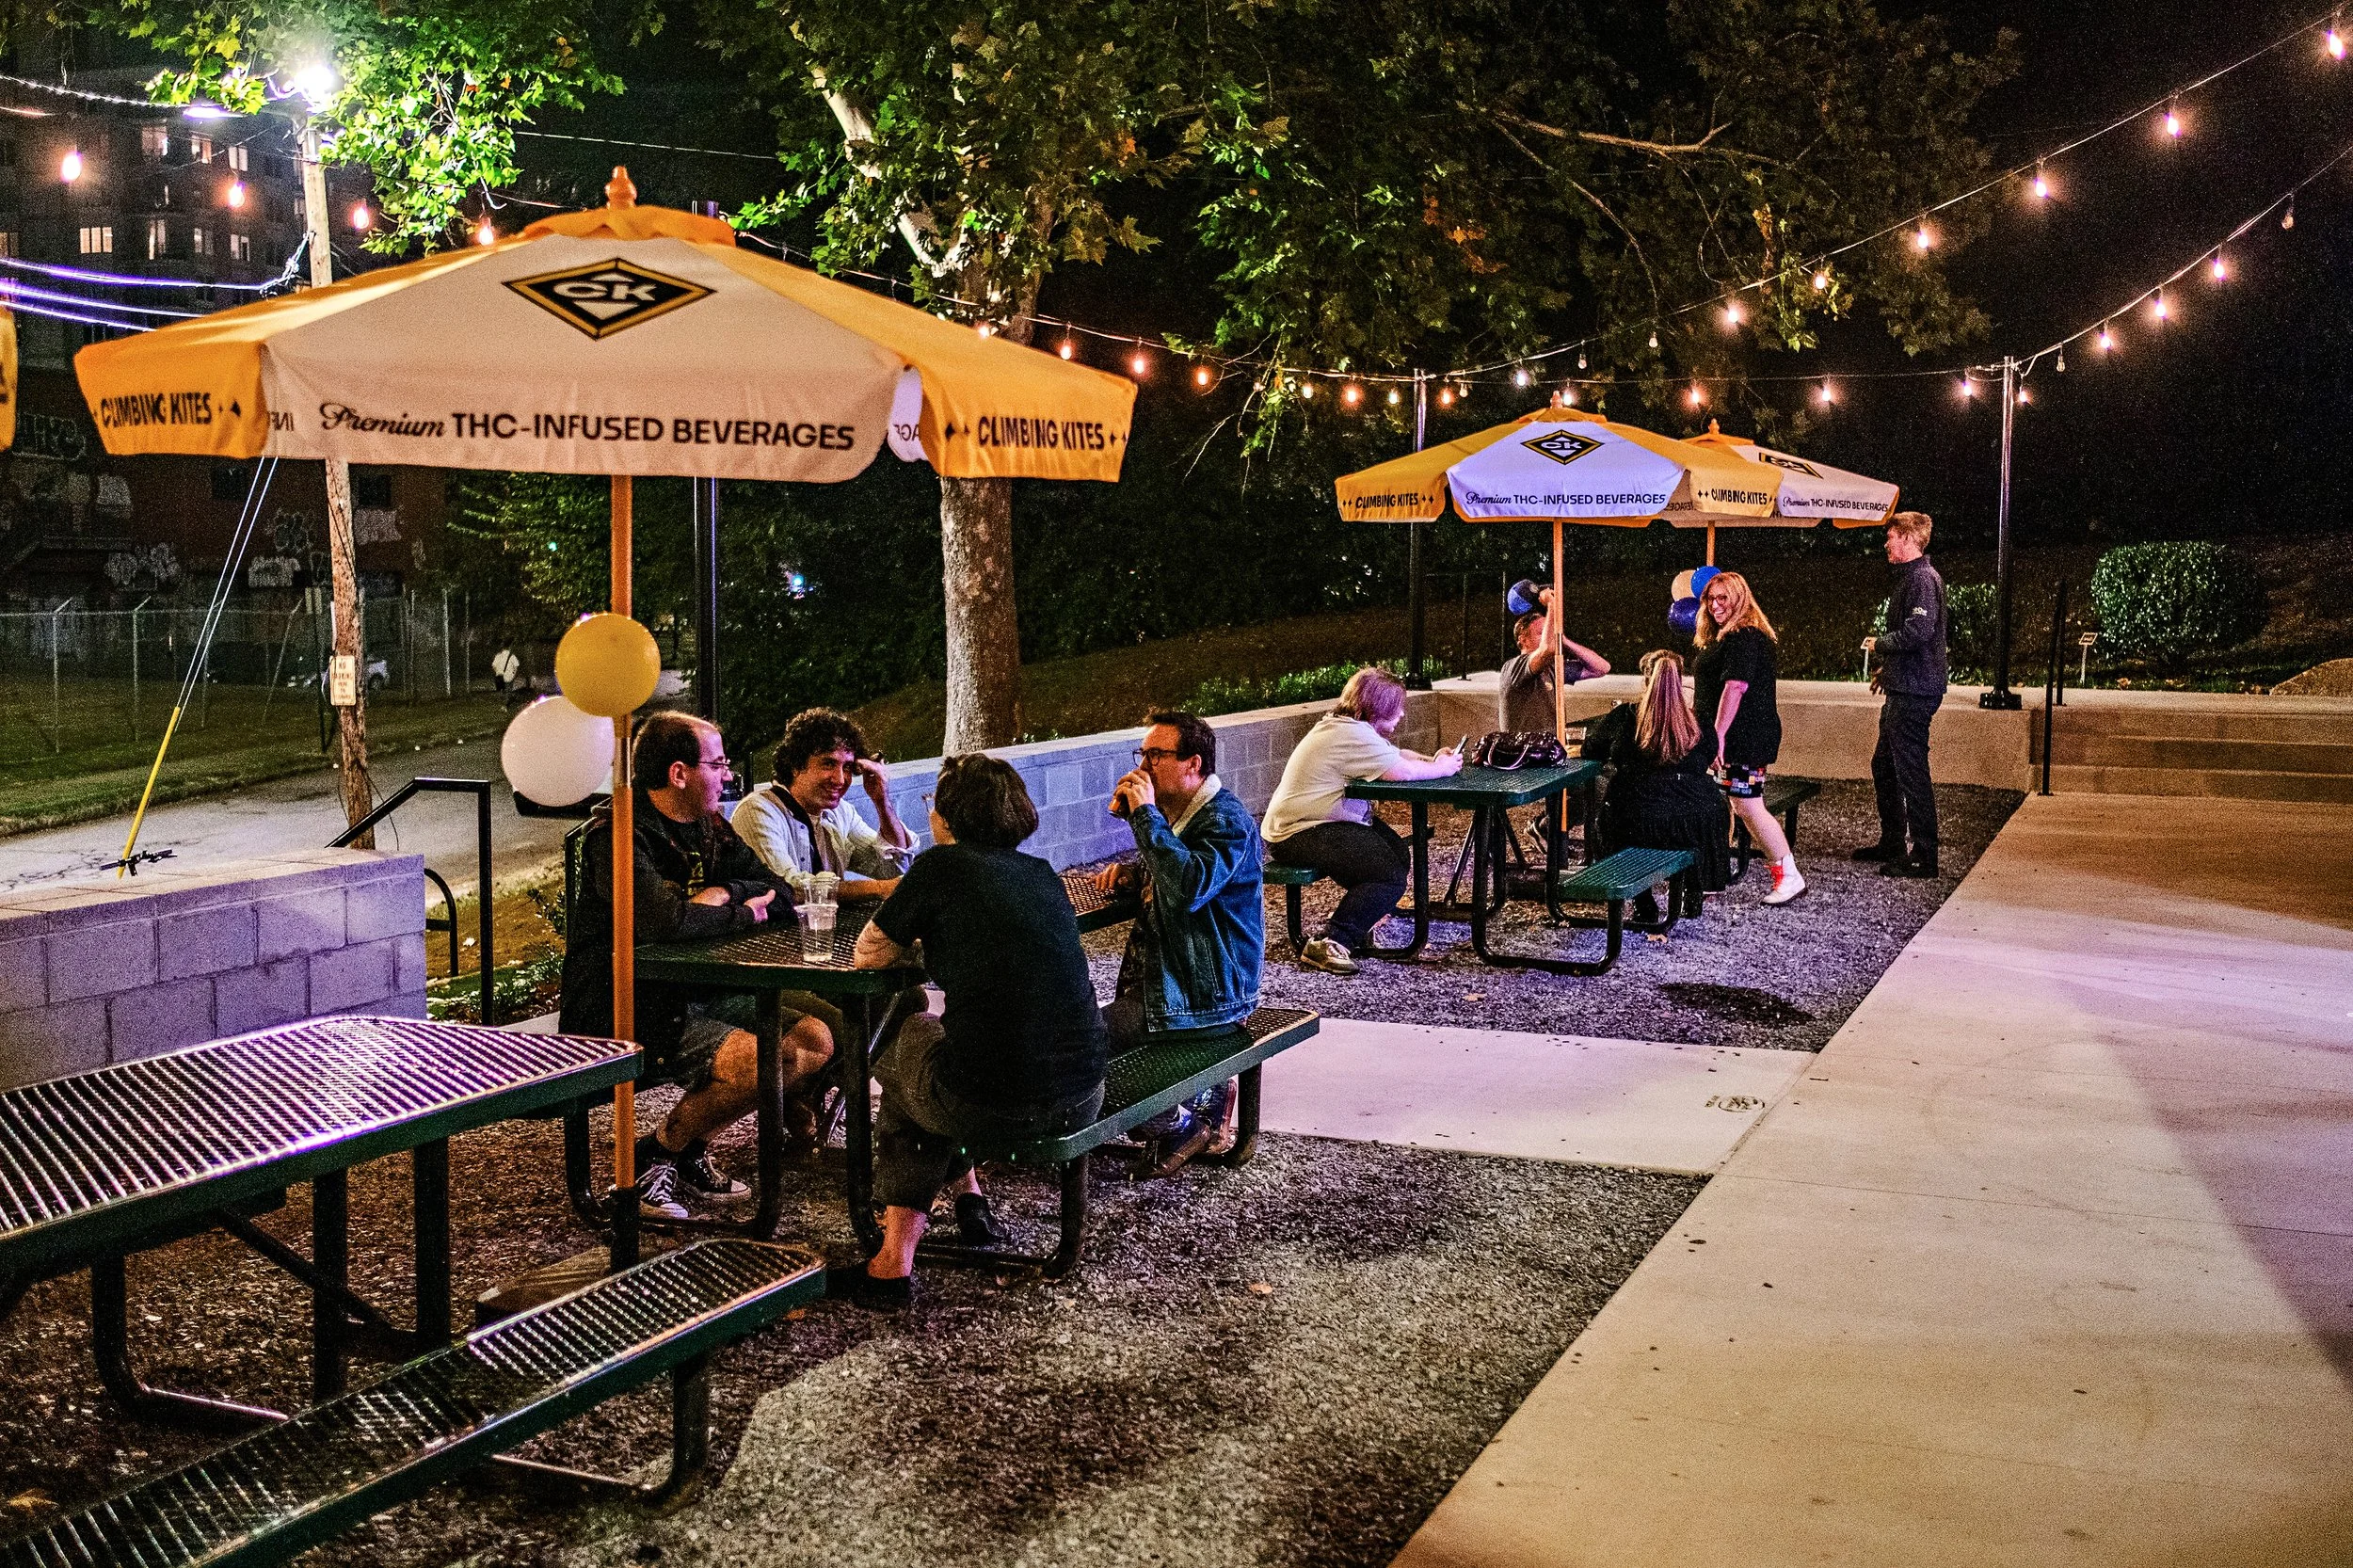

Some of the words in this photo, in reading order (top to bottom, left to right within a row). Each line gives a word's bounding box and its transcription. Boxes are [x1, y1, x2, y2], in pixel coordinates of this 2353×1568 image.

[553, 281, 658, 301] CK
[101, 393, 167, 428] CLIMBING
[169, 392, 213, 424] KITES
[319, 402, 446, 437] Premium
[451, 412, 665, 440] THC-INFUSED
[672, 418, 855, 450] BEVERAGES
[978, 416, 1059, 449] CLIMBING
[1062, 421, 1105, 450] KITES
[1355, 494, 1397, 509] CLIMBING
[1397, 492, 1418, 506] KITES
[1465, 491, 1513, 504] Premium
[1513, 494, 1593, 504] THC-INFUSED
[1595, 493, 1666, 504] BEVERAGES
[1711, 488, 1746, 504] CLIMBING
[1747, 491, 1768, 504] KITES
[1851, 502, 1889, 512] BEVERAGES
